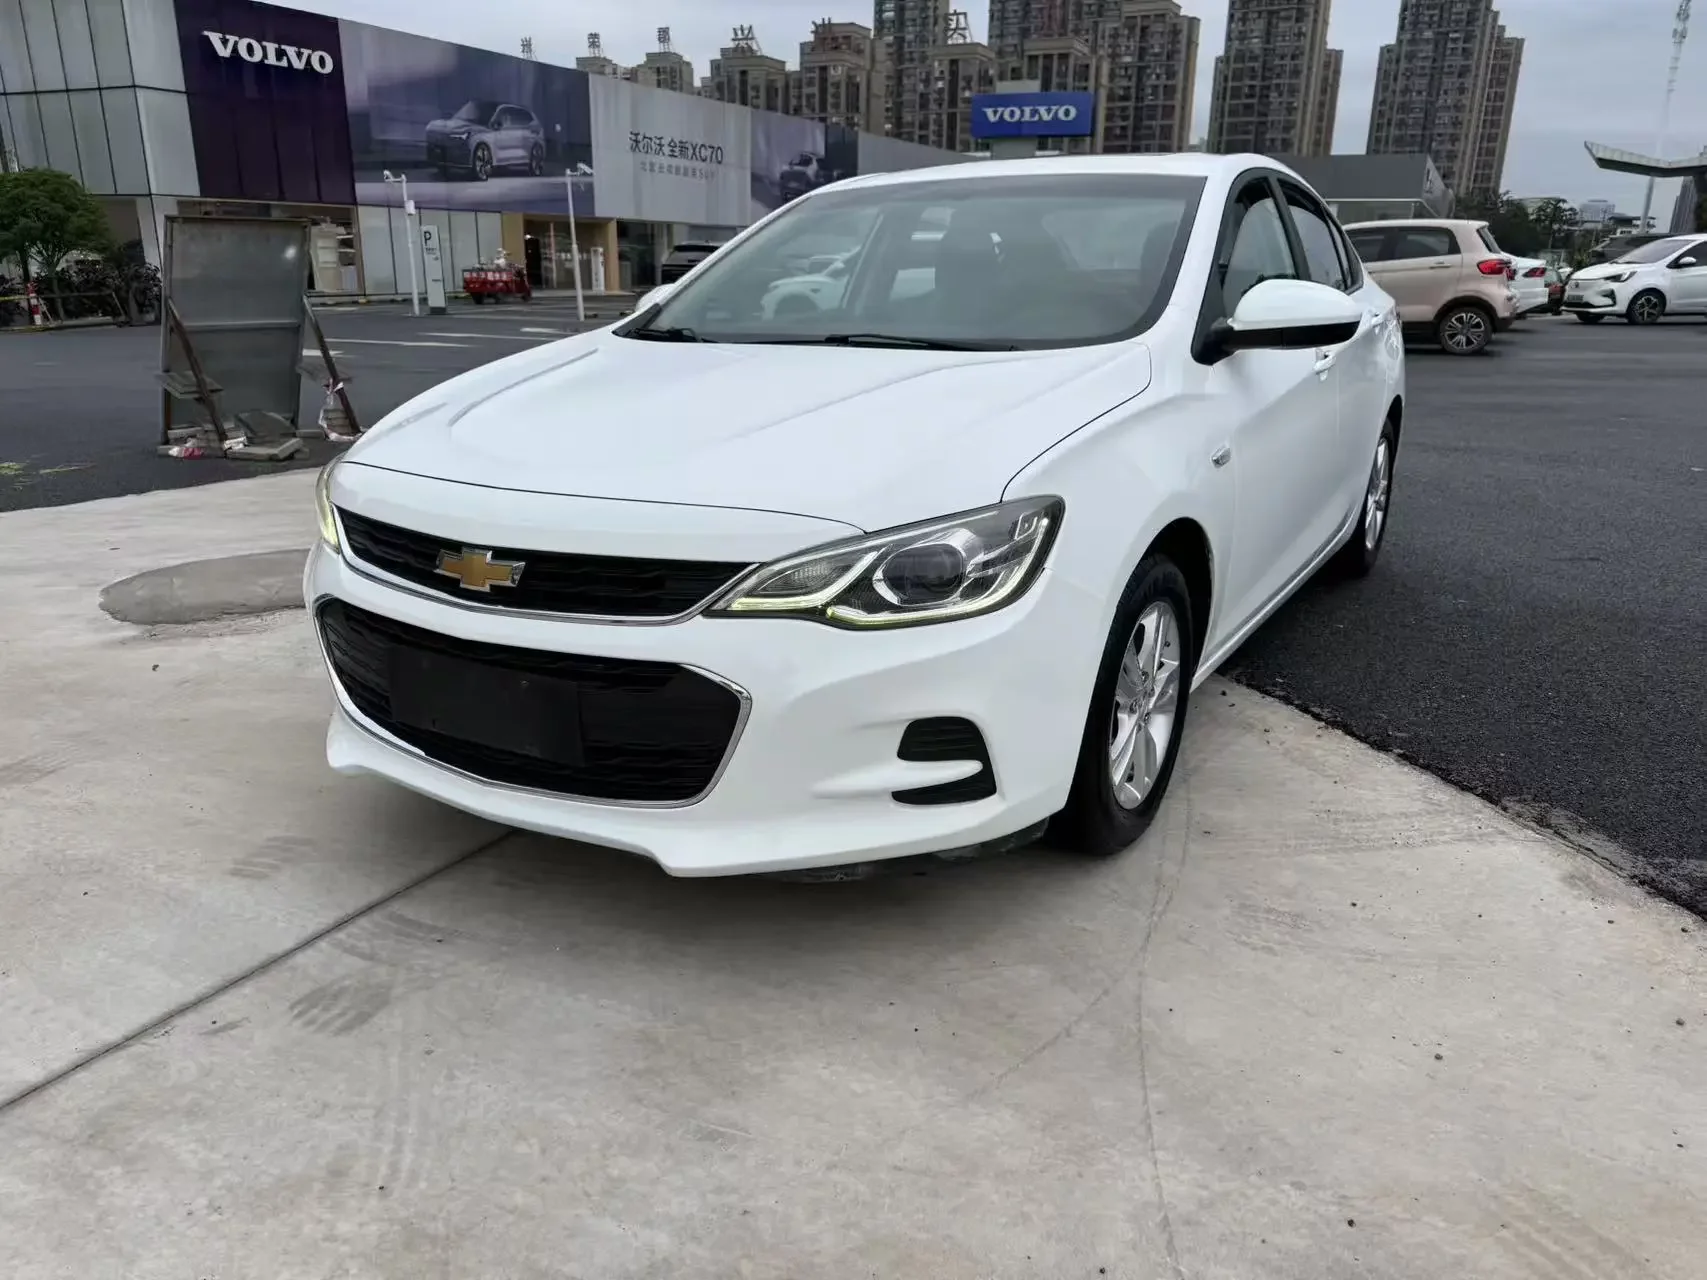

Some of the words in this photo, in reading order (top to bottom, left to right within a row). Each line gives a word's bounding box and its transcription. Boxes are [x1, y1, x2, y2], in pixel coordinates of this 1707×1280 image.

[202, 30, 334, 74] VOLVO
[982, 105, 1077, 124] VOLVO
[628, 131, 665, 157] 沃尔沃
[667, 138, 724, 165] 全新XC70
[423, 230, 432, 247] P
